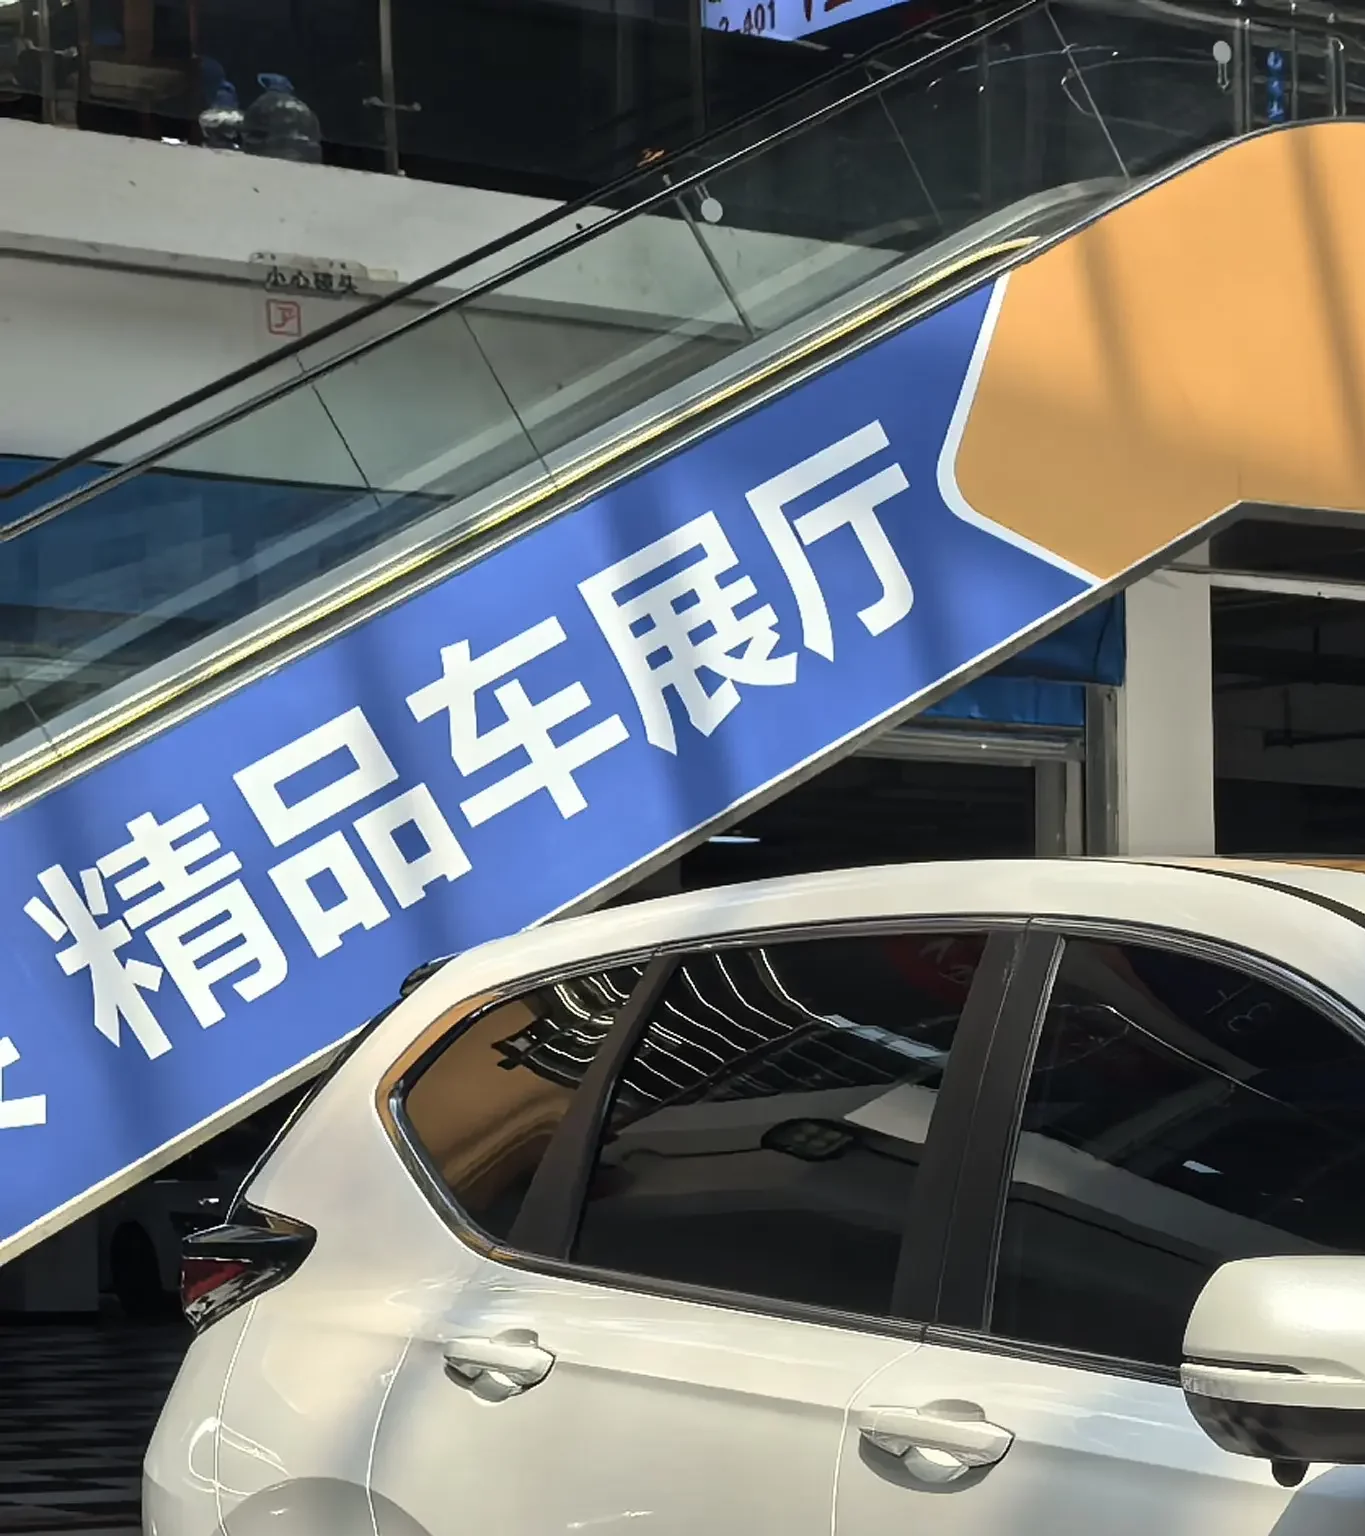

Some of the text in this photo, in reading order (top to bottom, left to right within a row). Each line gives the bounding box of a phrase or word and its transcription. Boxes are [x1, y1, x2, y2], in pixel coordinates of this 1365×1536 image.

[24, 419, 916, 1061] 精品车展厅
